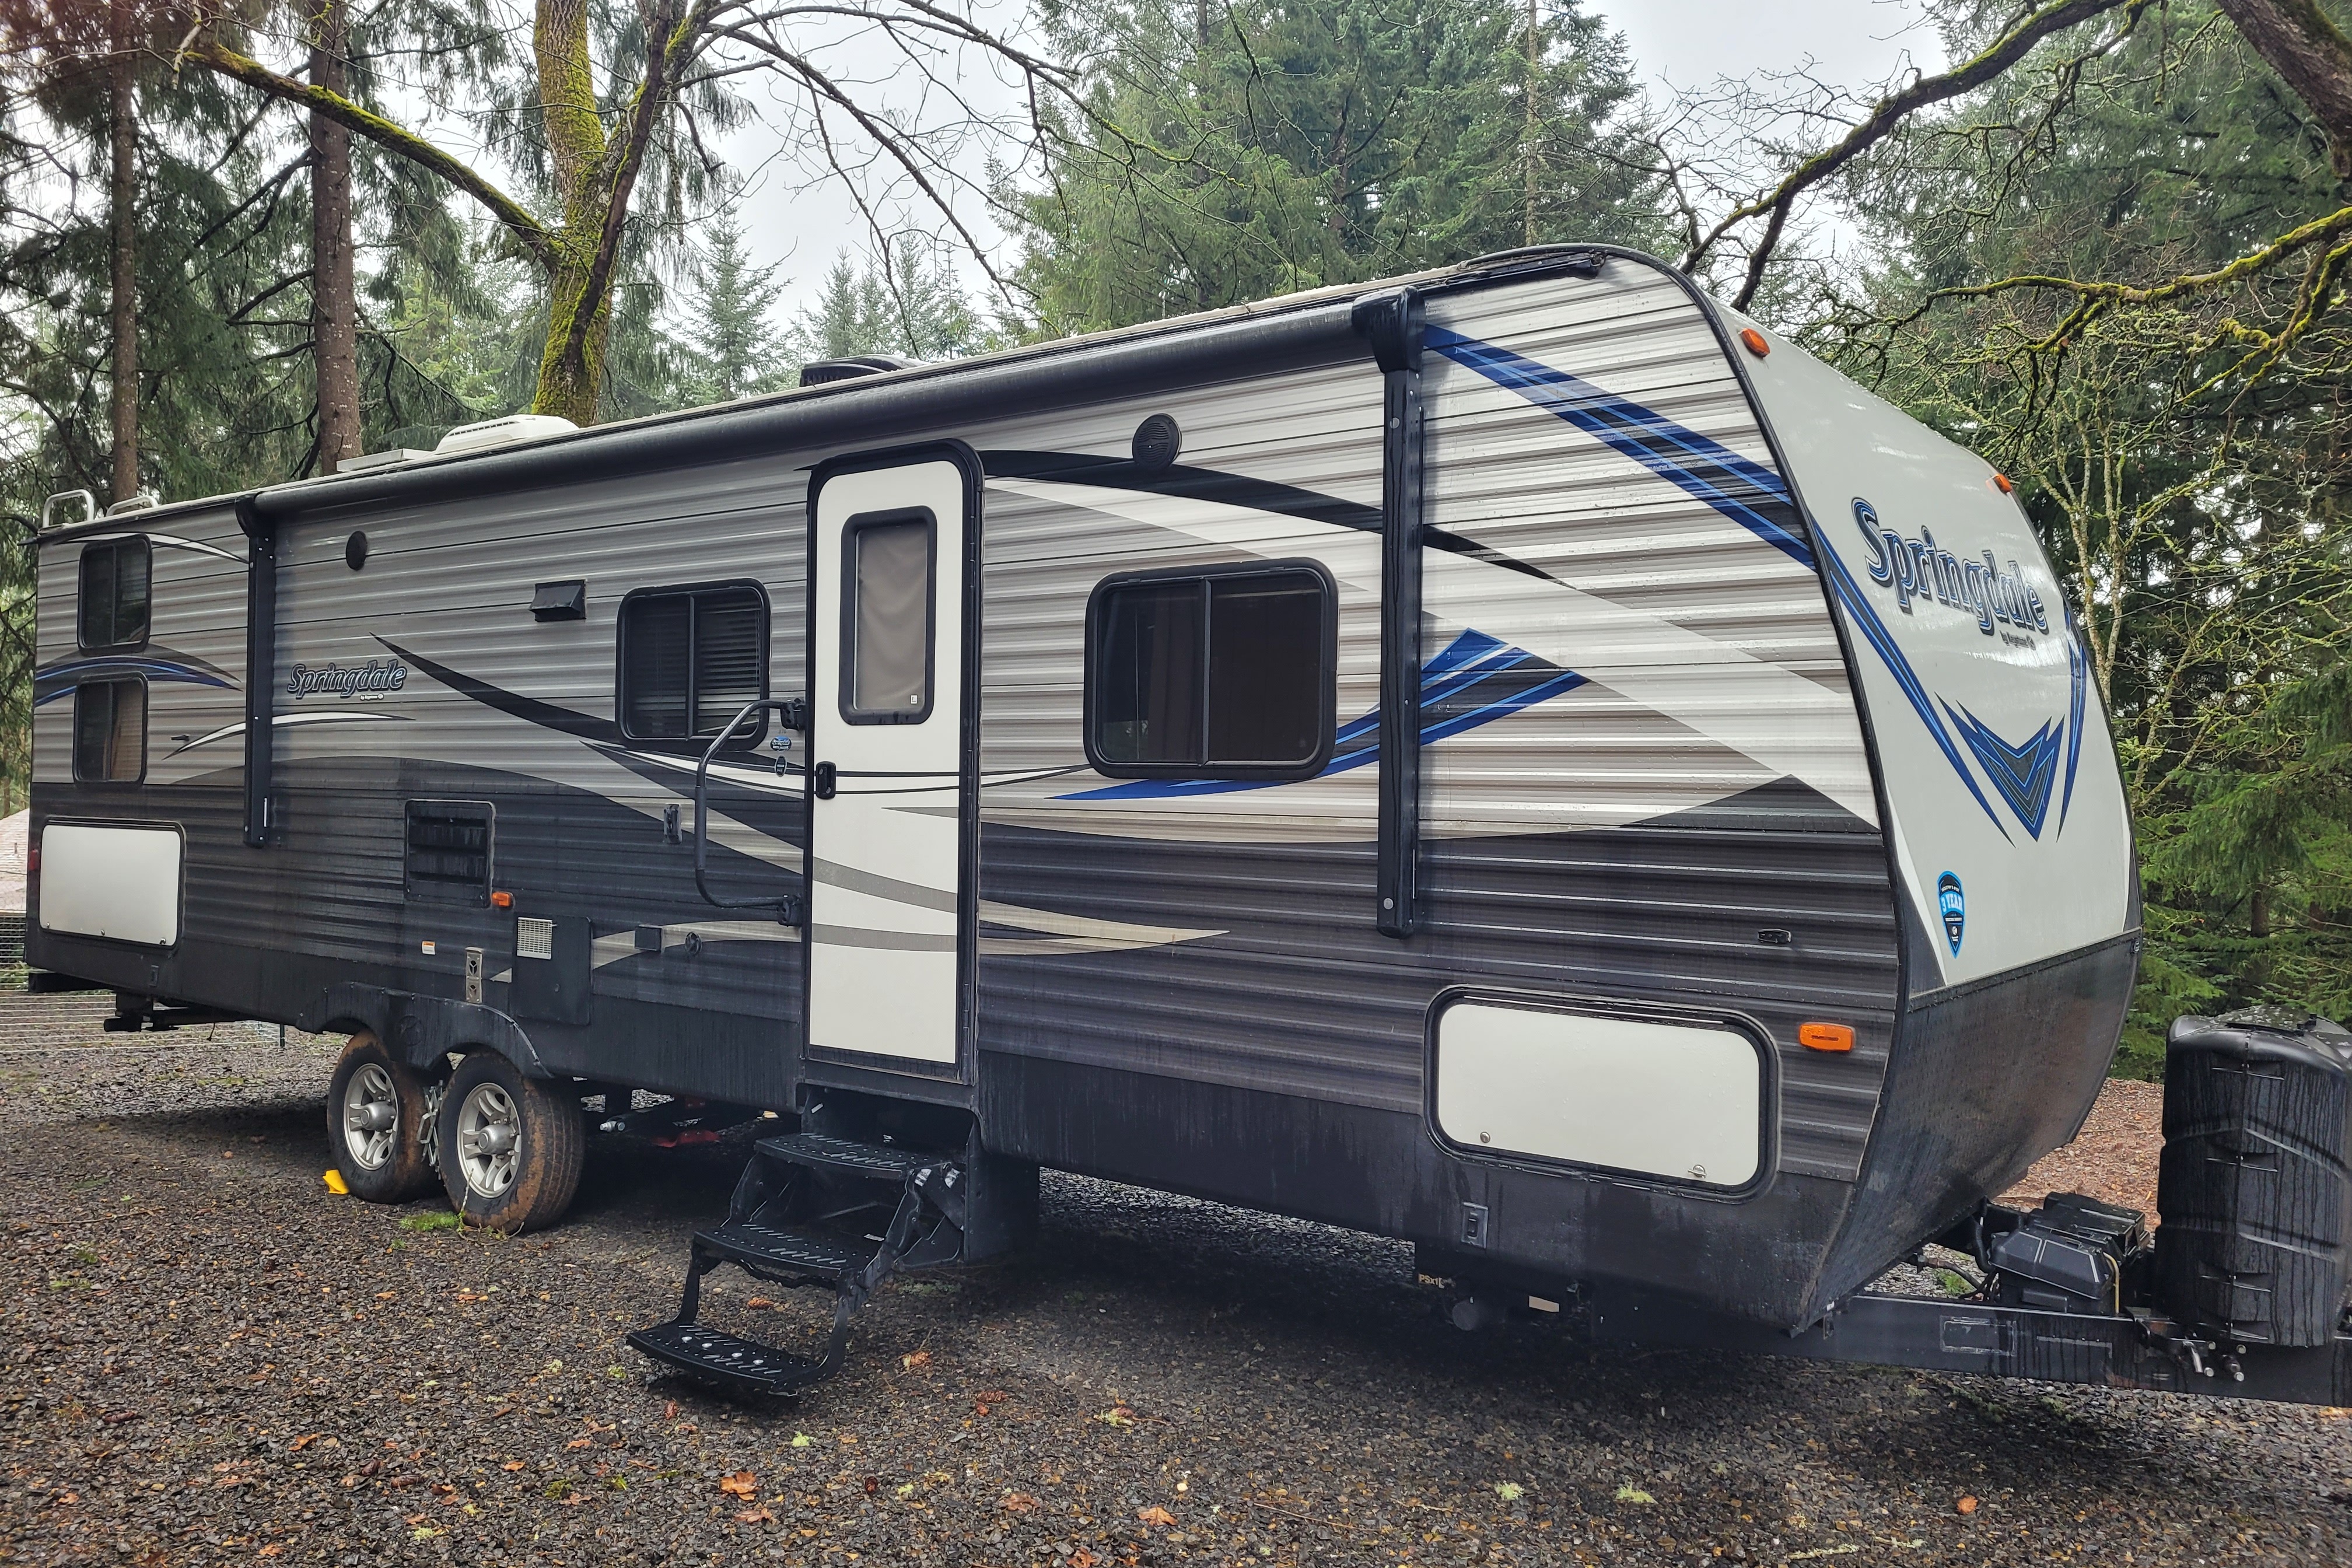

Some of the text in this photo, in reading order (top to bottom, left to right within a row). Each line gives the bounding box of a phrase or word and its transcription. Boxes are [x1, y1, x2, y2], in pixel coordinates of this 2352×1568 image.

[1852, 496, 2049, 636] Springdale
[288, 659, 408, 699] Springdale
[1946, 893, 1964, 912] YEAR
